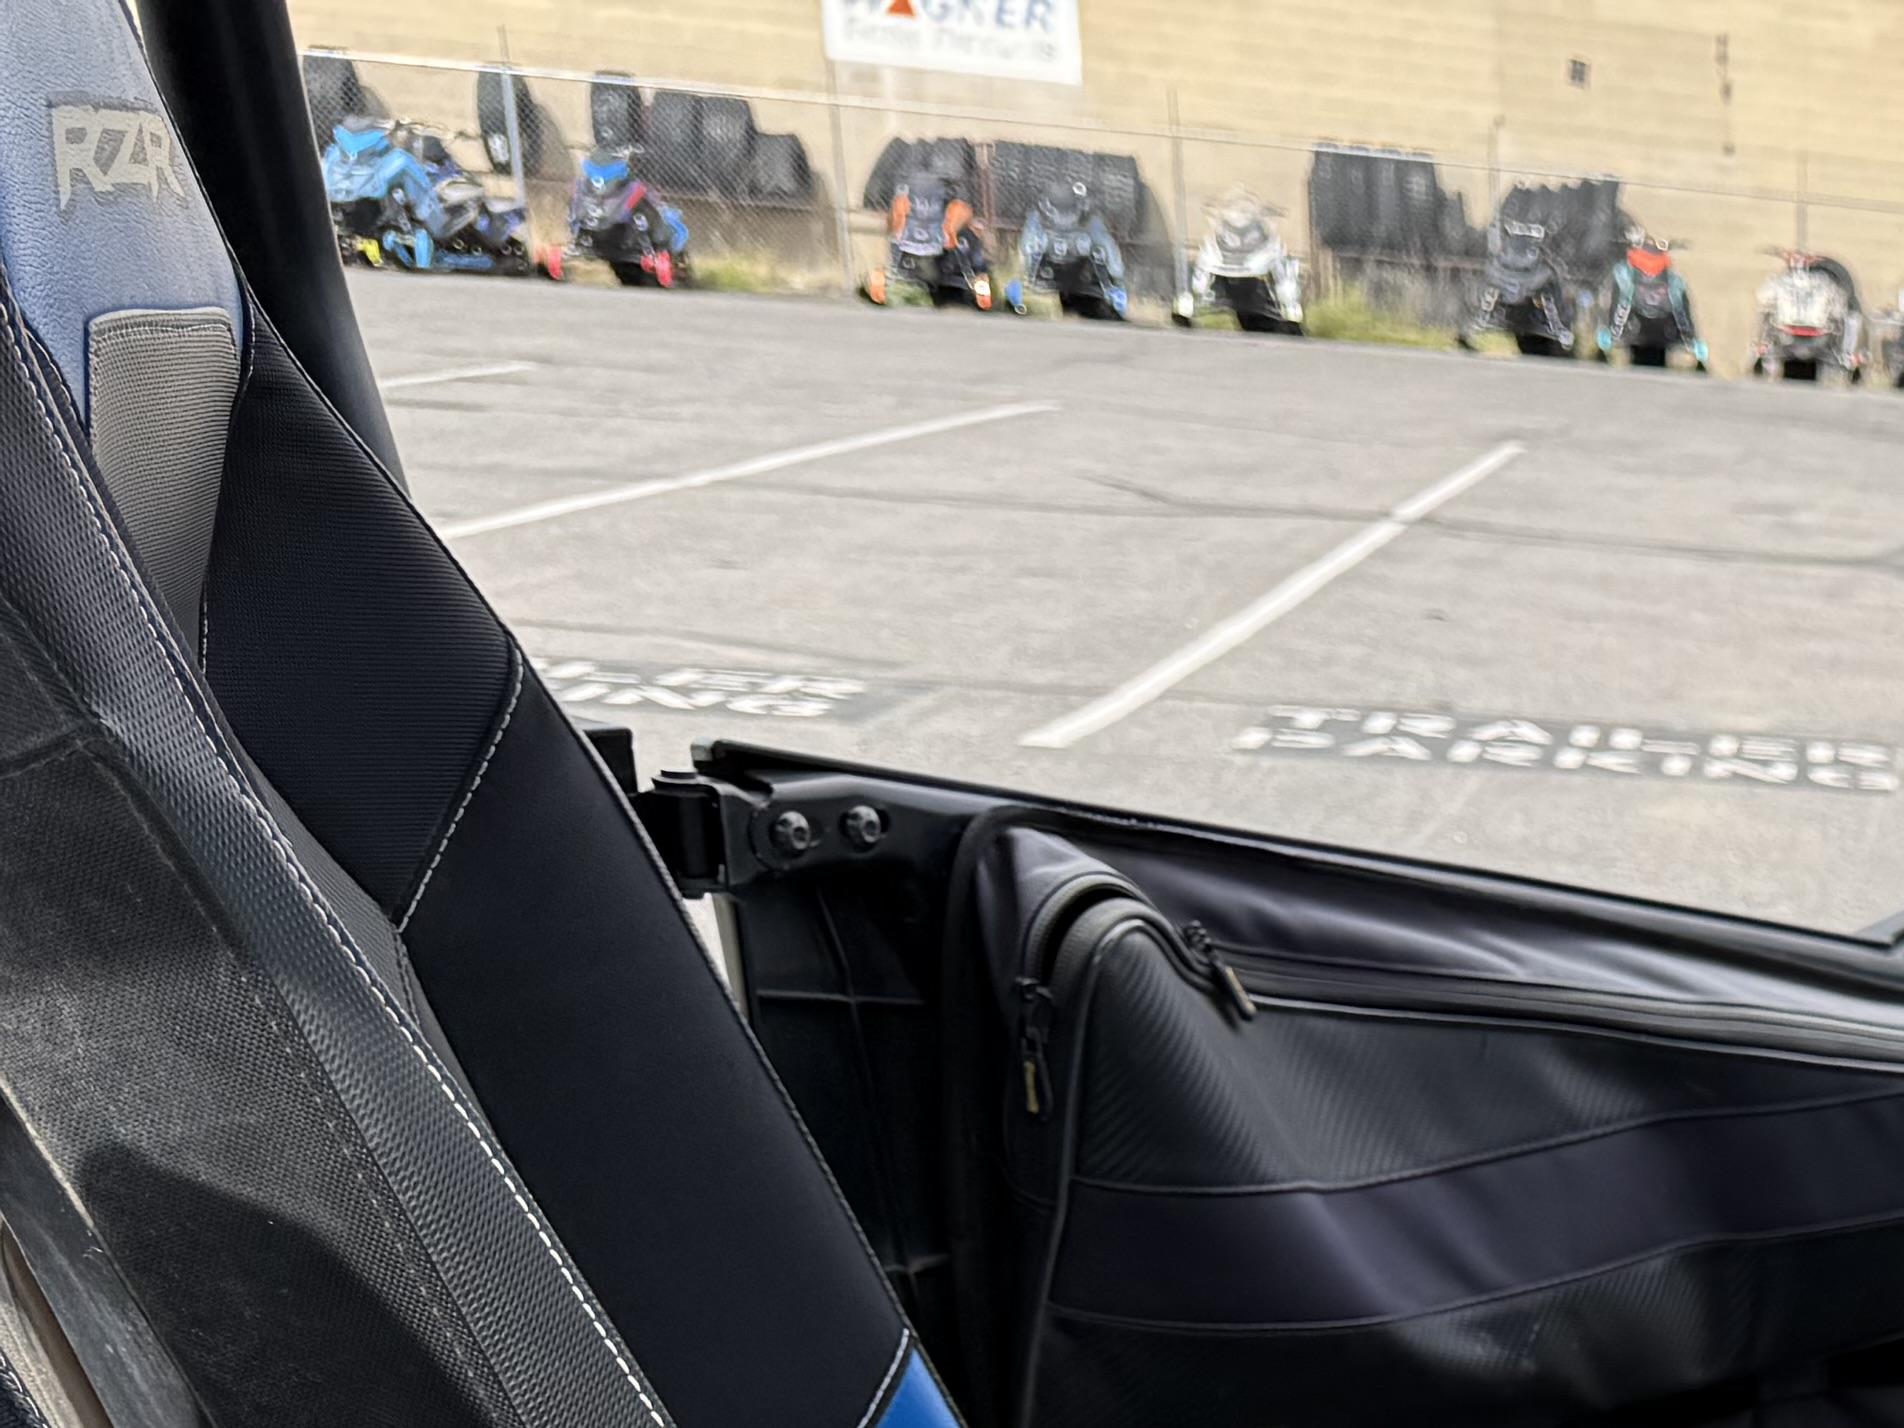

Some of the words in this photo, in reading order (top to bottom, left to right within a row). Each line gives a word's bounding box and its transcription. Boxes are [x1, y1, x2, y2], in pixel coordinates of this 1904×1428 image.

[838, 0, 1052, 34] GNER
[50, 105, 187, 211] RZR
[1231, 726, 1899, 792] PARKING
